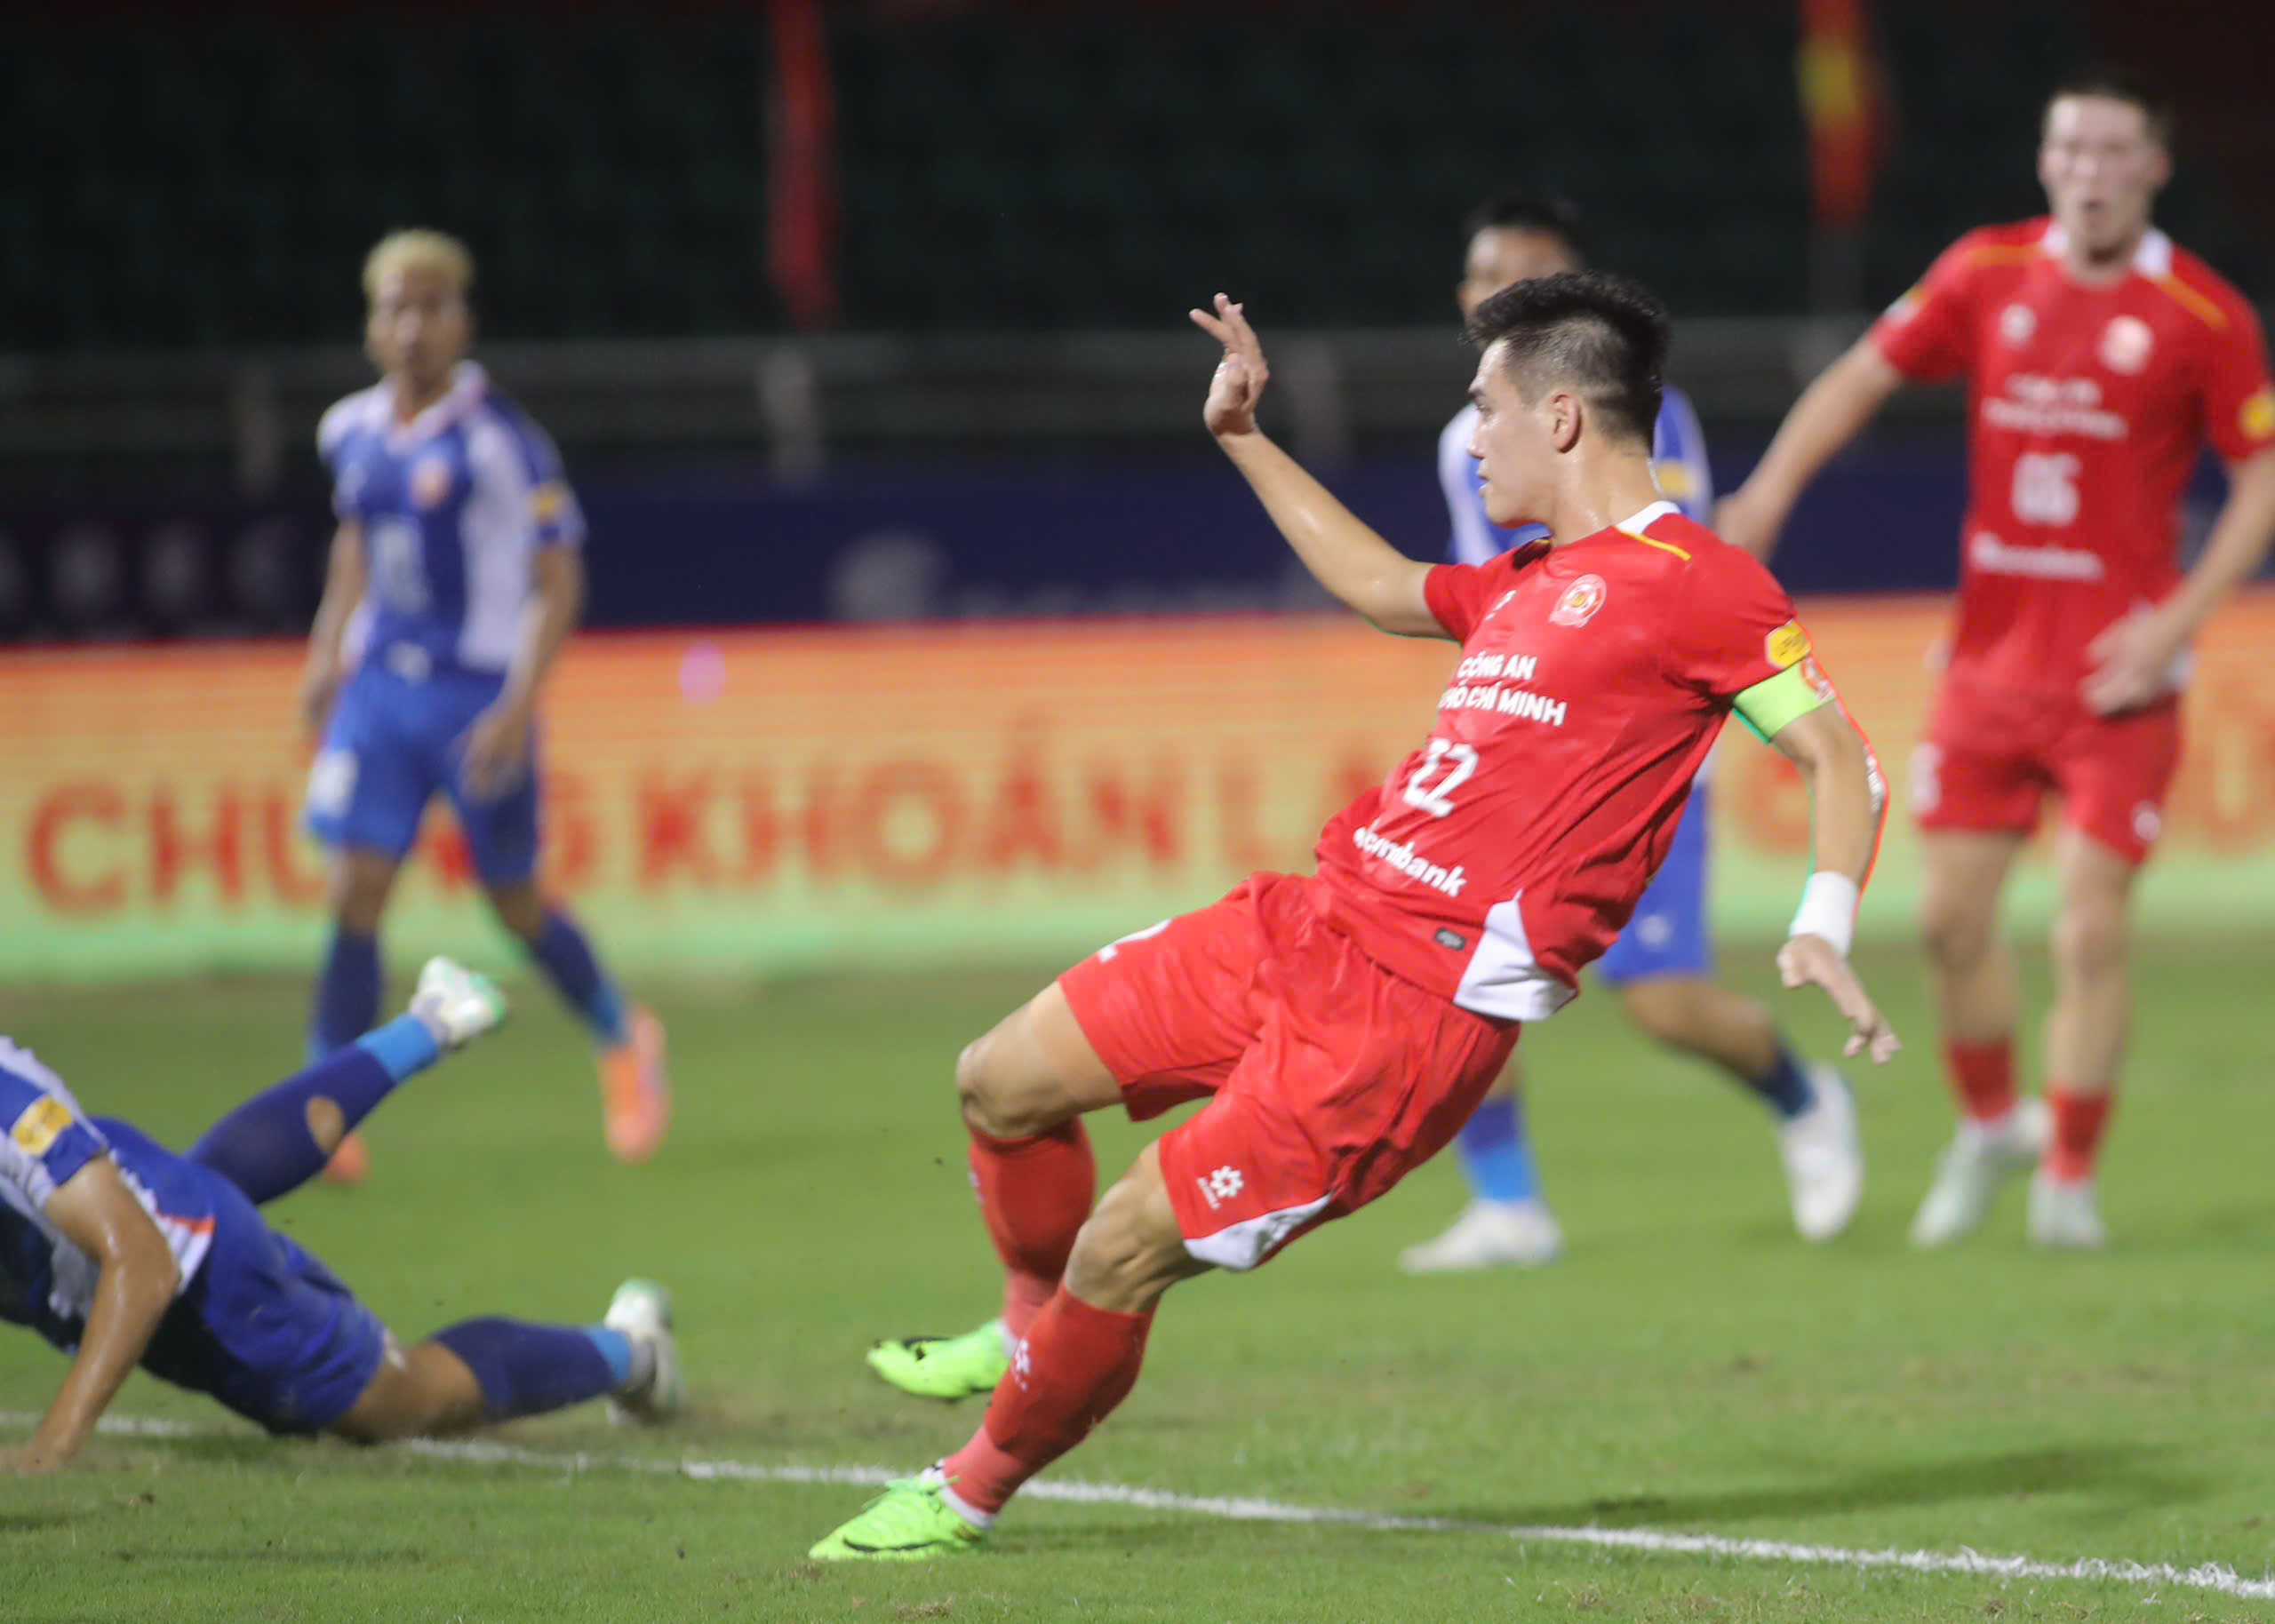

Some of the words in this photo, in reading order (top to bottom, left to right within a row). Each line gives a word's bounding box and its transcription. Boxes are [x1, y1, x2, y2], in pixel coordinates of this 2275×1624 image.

[1502, 653, 1538, 681] AN
[1497, 689, 1569, 727] MINH
[1402, 737, 1479, 818] 22
